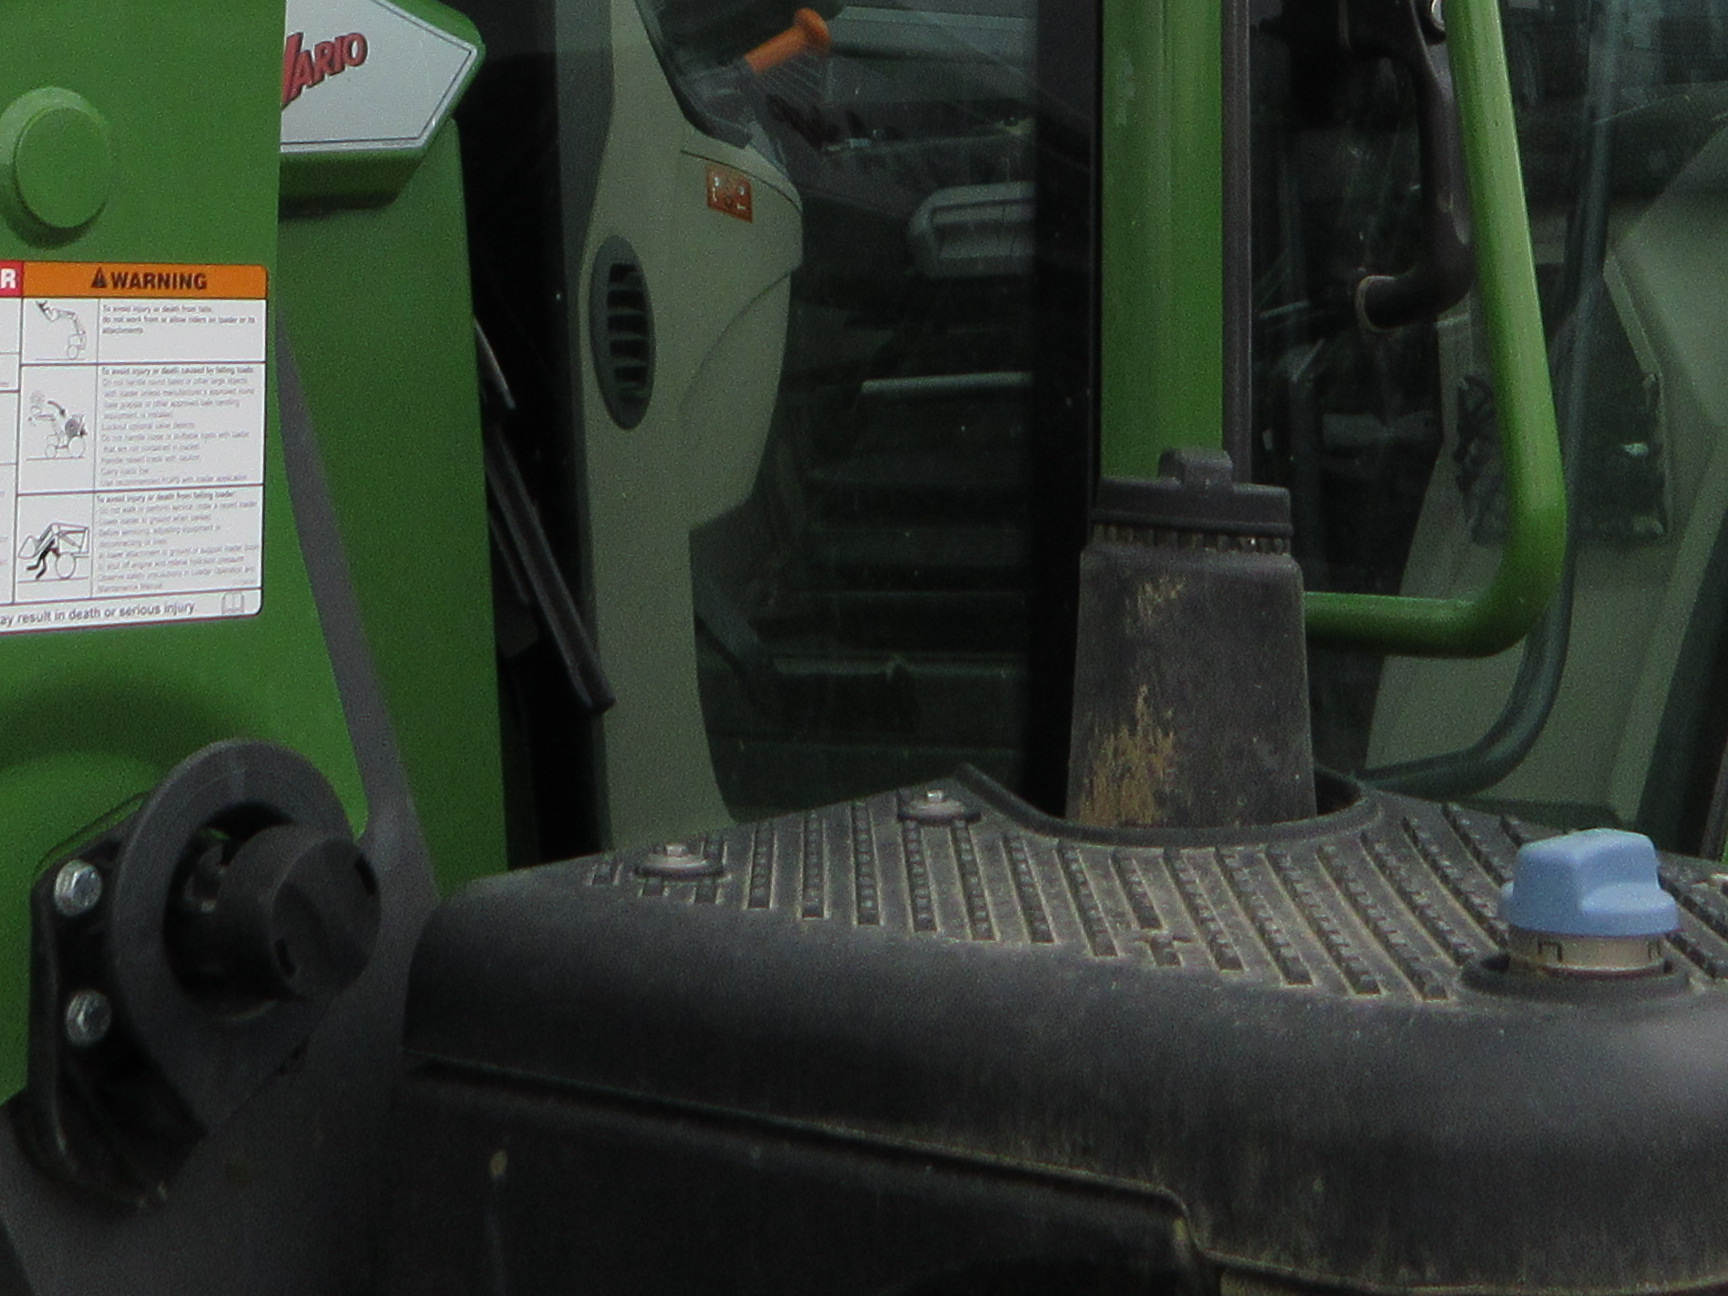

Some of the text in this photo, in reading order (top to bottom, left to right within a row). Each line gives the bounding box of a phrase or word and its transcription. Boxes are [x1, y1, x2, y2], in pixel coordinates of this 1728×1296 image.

[111, 271, 207, 290] WARNING
[17, 611, 51, 624] result
[54, 609, 65, 621] in
[69, 606, 100, 620] death
[104, 608, 115, 617] or
[120, 603, 161, 616] serious
[164, 601, 195, 614] injury
